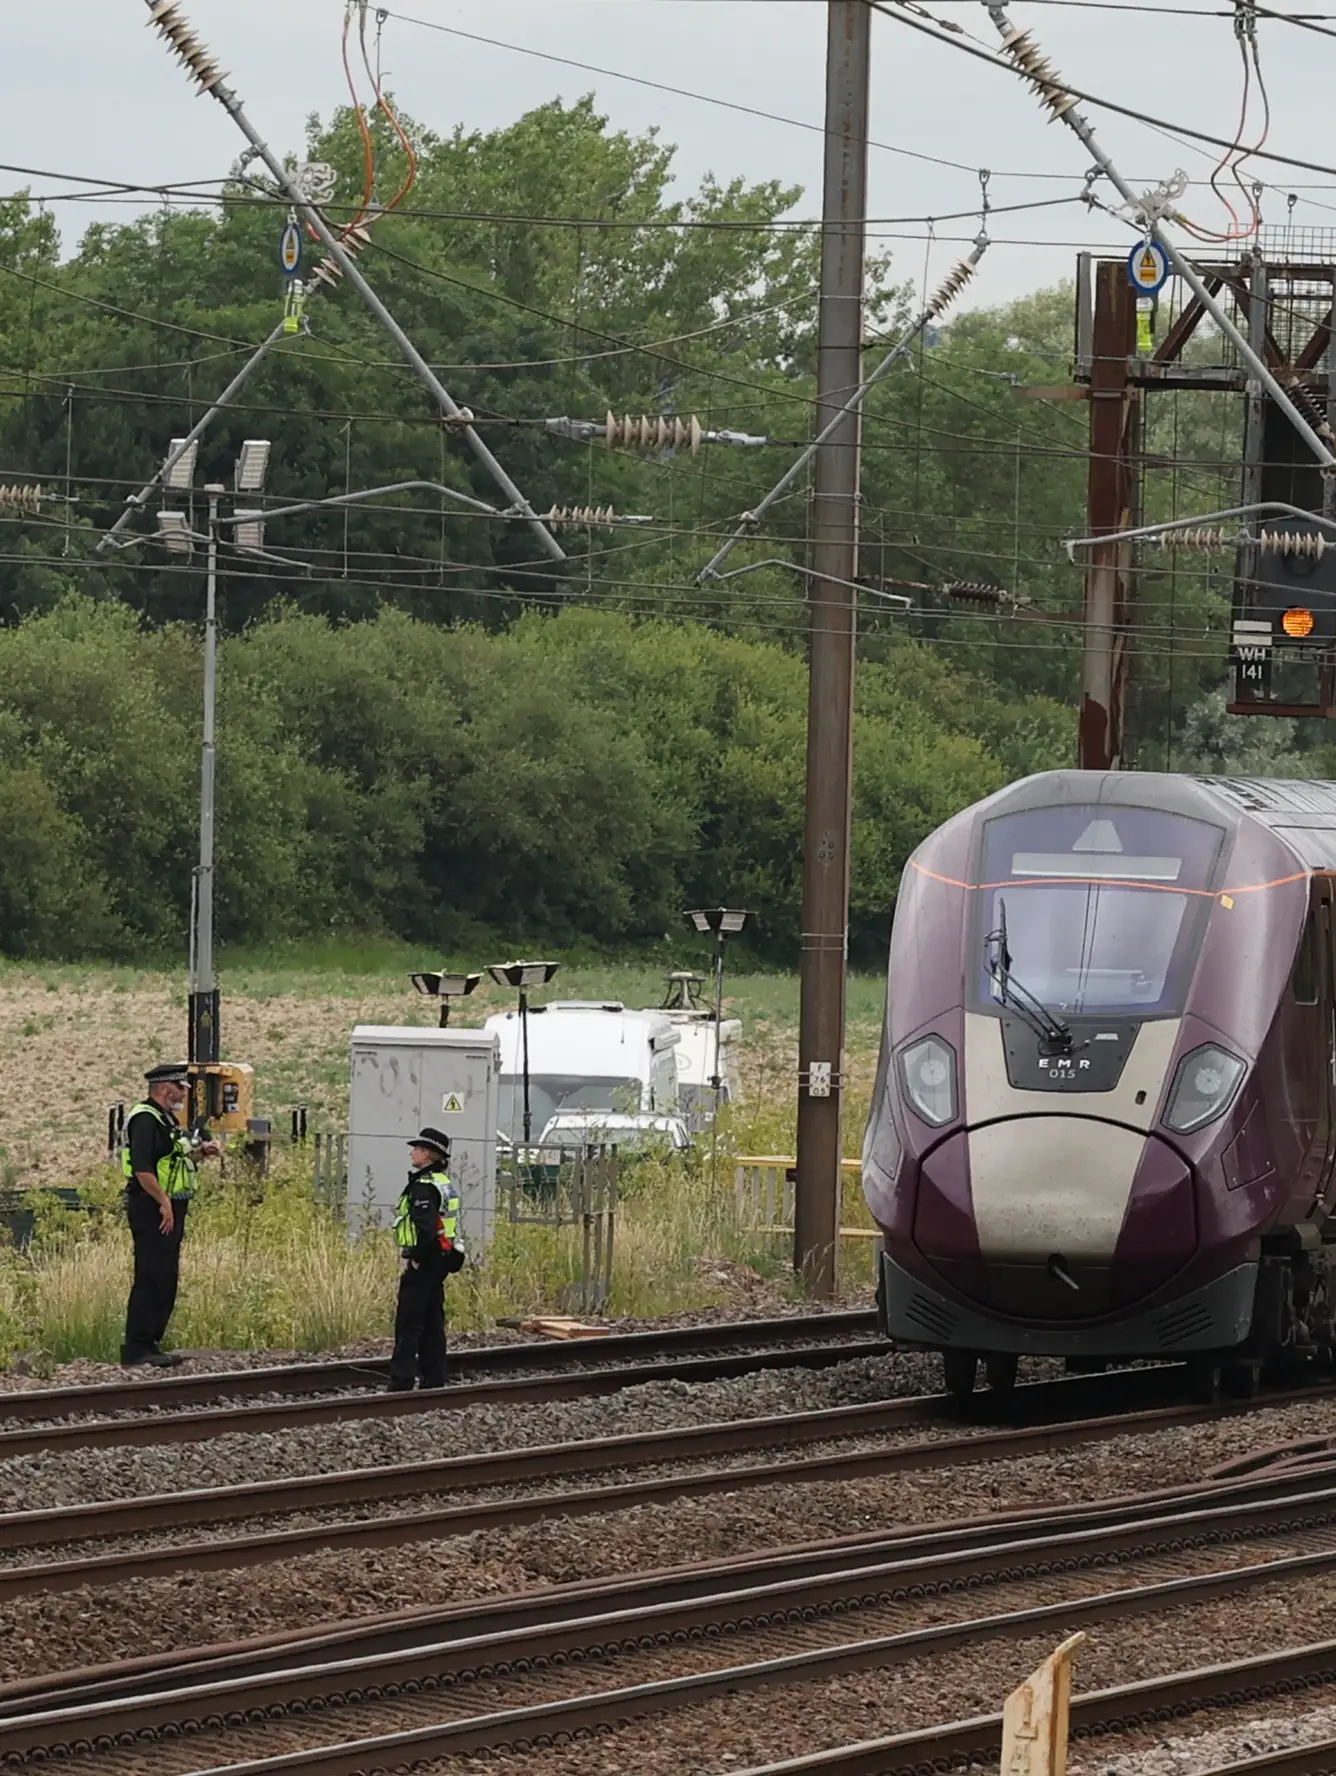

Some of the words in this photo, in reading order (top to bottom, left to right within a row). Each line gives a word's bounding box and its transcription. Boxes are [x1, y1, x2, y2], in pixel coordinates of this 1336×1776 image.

[1238, 647, 1266, 661] WH
[1242, 664, 1262, 679] 141
[1049, 1069, 1076, 1079] 015
